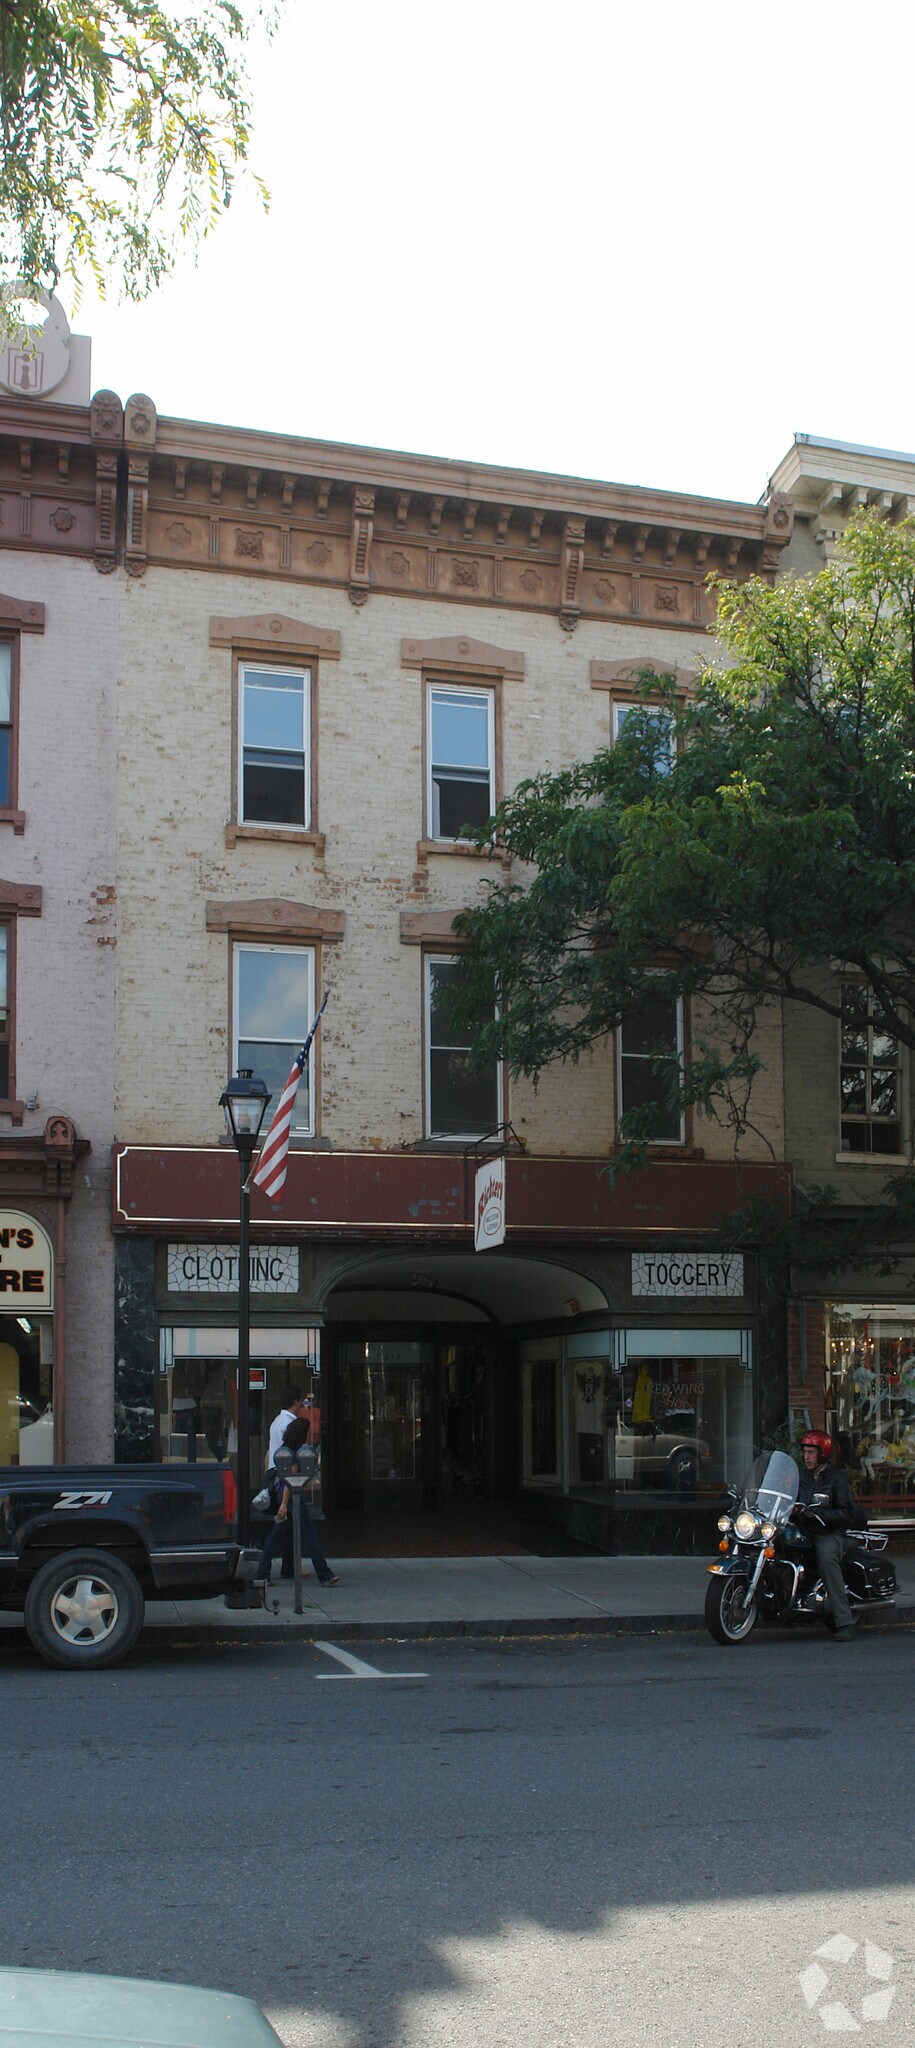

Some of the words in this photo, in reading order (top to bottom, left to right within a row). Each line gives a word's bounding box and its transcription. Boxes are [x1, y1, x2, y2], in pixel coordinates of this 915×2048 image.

[182, 1256, 284, 1281] CLOTING
[644, 1263, 731, 1286] TOGGERY
[673, 1383, 705, 1394] WING
[53, 1490, 113, 1510] Z71
